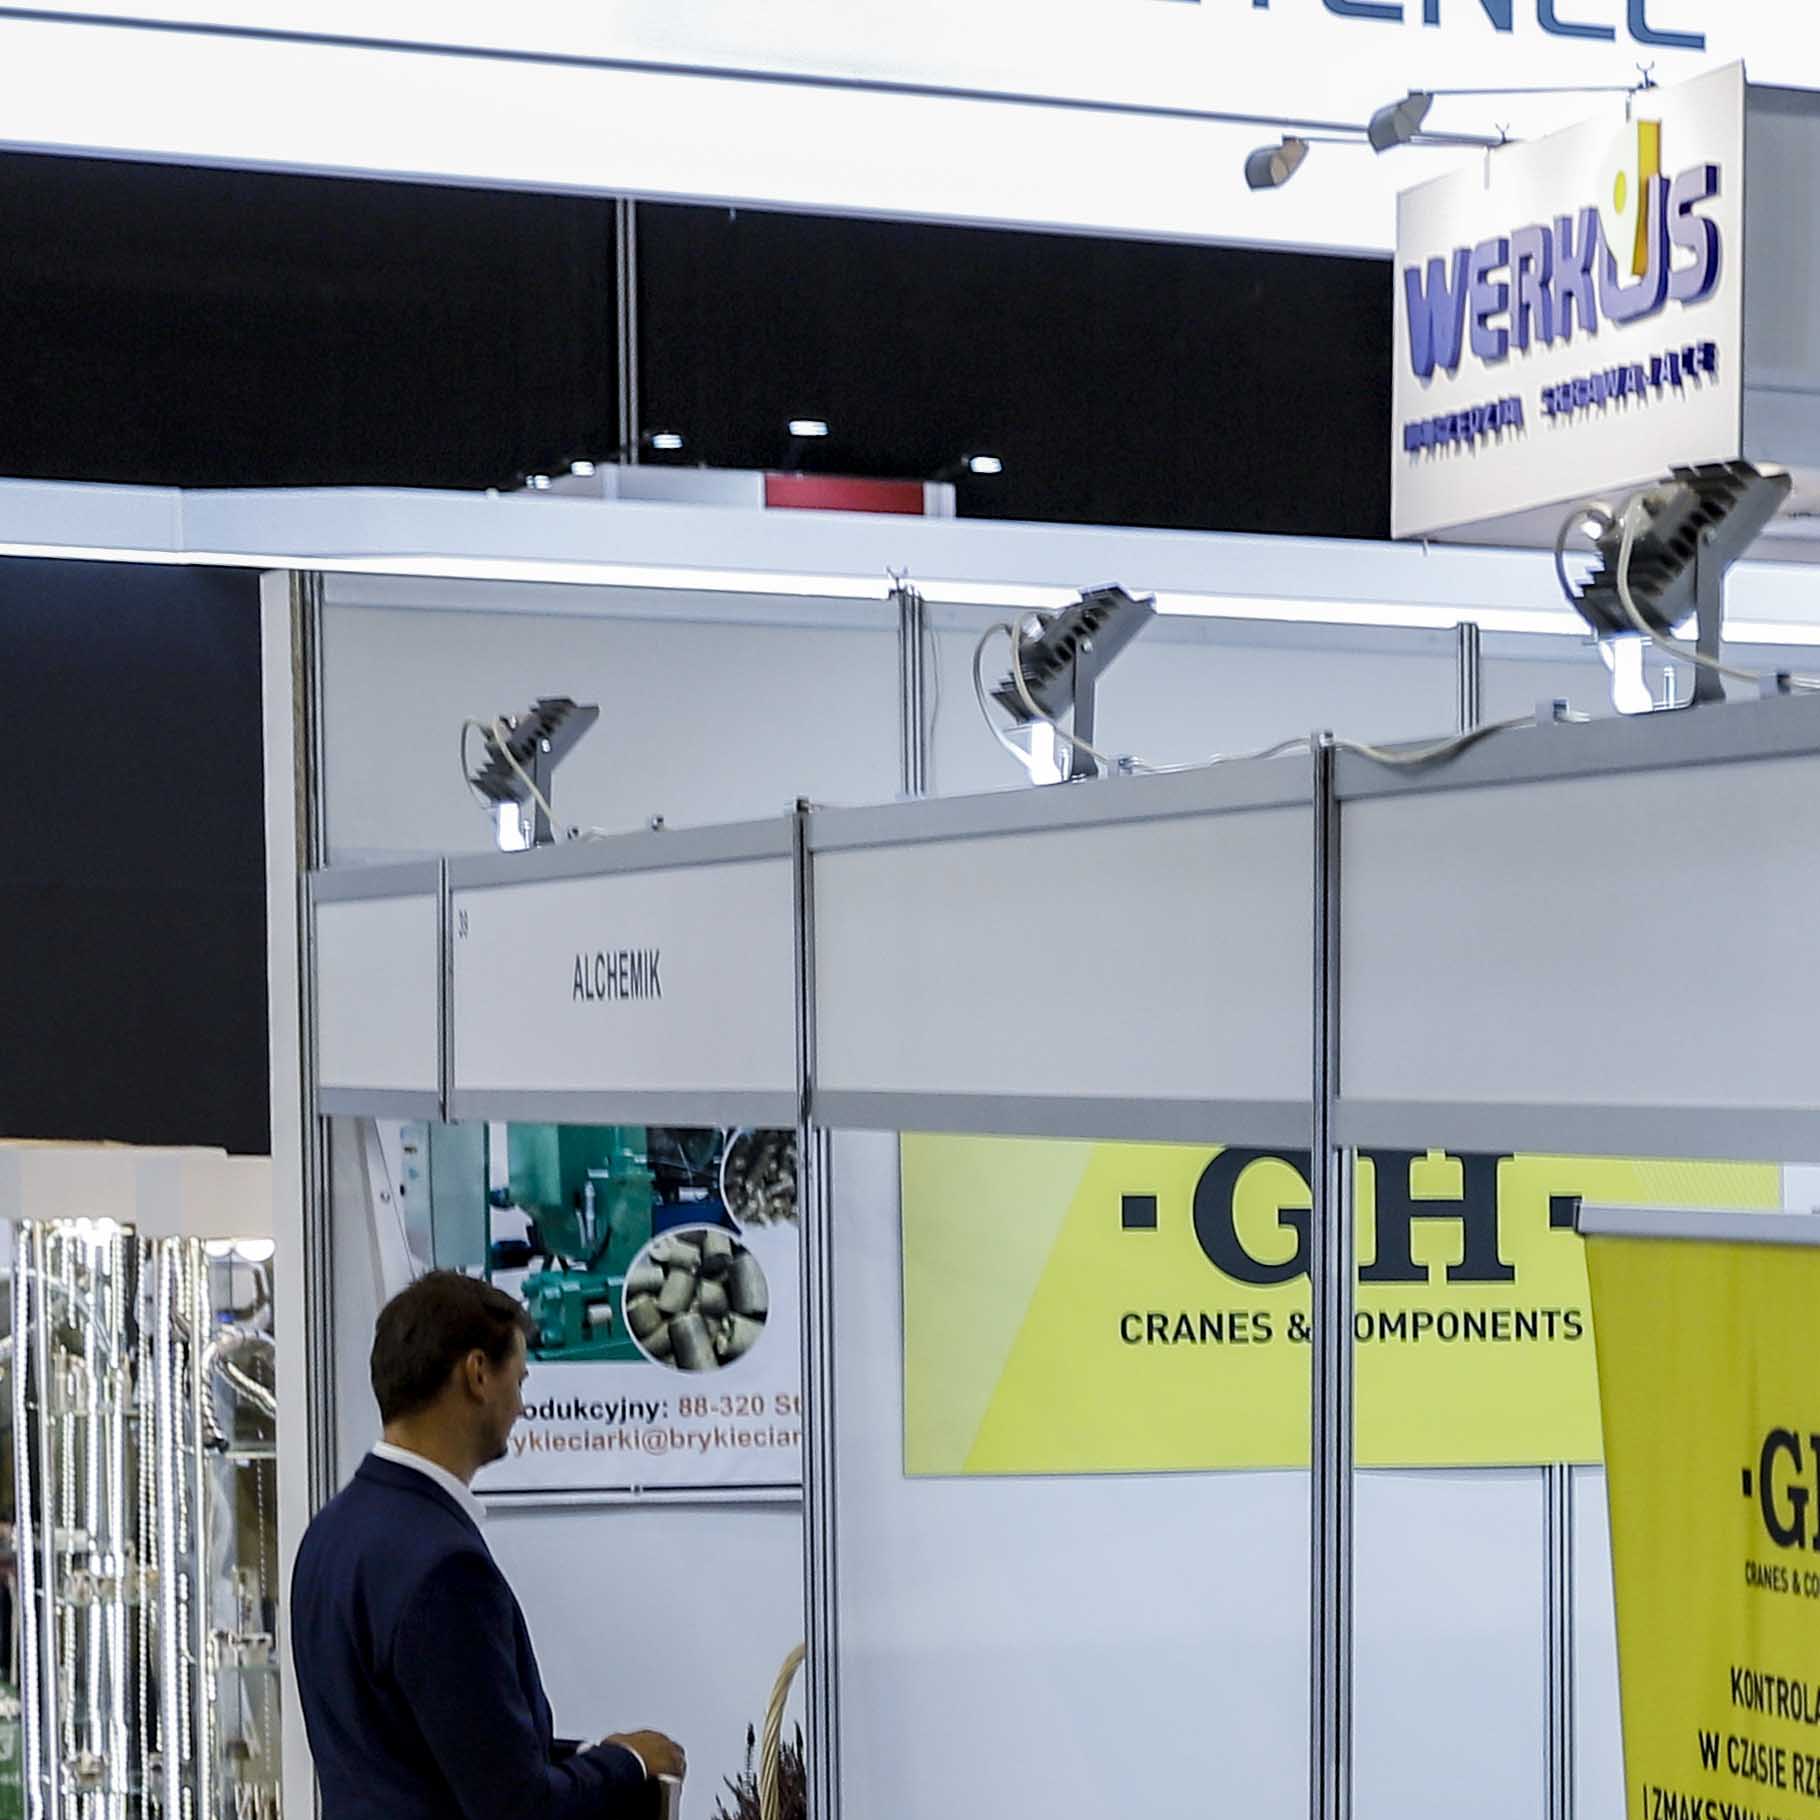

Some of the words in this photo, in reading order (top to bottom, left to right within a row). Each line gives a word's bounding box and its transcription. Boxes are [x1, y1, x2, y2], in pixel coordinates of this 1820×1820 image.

[1404, 163, 1722, 383] WERKUS
[572, 948, 662, 1002] ALCHEMIK
[1194, 1147, 1516, 1285] GH
[1120, 1311, 1273, 1346] CRANES
[1286, 1312, 1311, 1343] &
[1352, 1309, 1584, 1343] OMPONENTS
[521, 1396, 669, 1424] odukcyjny:
[679, 1394, 765, 1418] 88-320
[1745, 1561, 1790, 1594] CRANES
[1699, 1729, 1720, 1772] W
[1727, 1737, 1787, 1791] CZASIE
